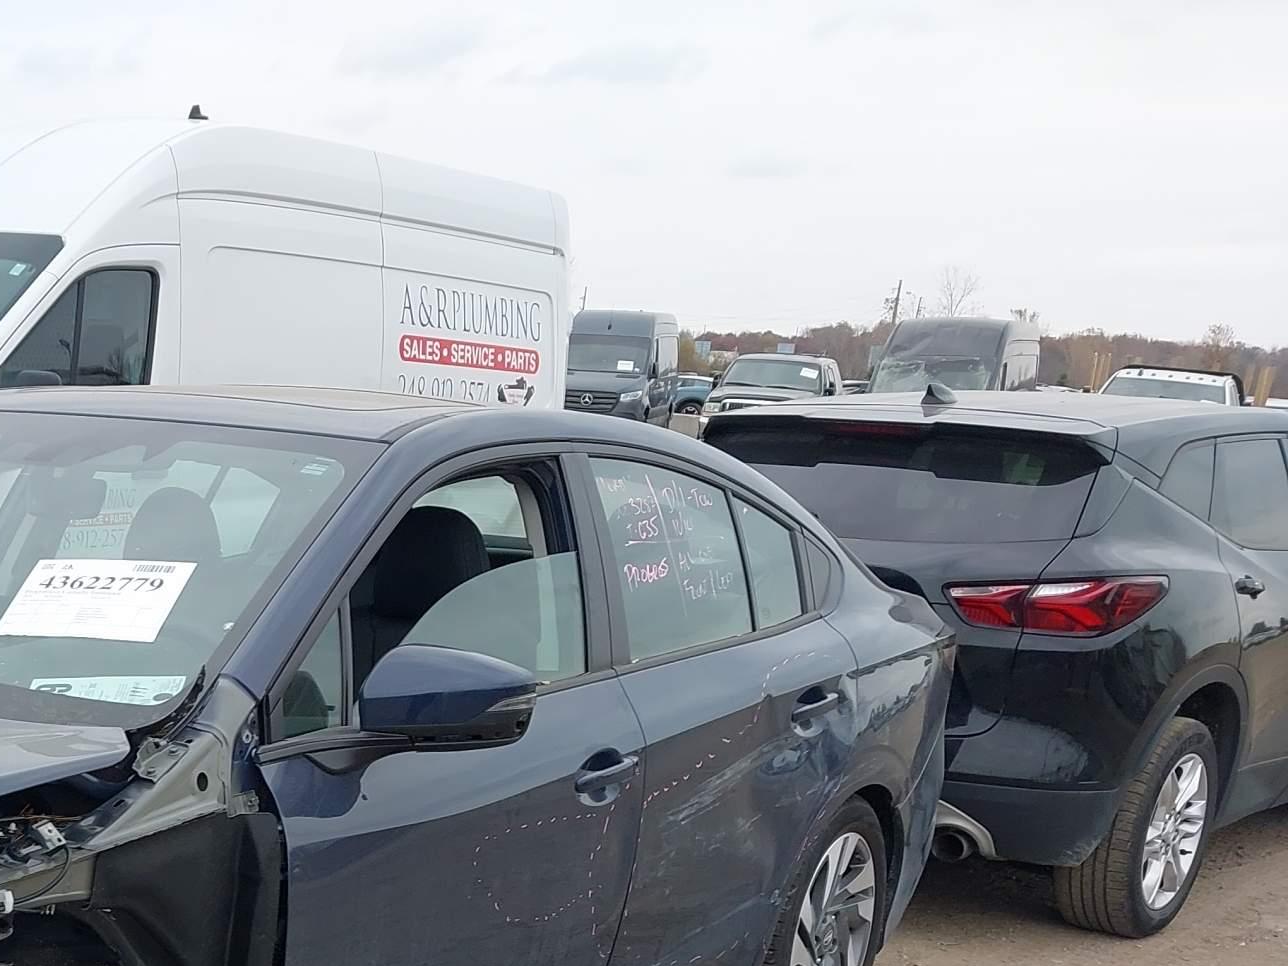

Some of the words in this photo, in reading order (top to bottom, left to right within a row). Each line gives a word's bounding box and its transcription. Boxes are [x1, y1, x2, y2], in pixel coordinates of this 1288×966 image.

[403, 338, 441, 361] SALES
[450, 344, 495, 368] SERVICE
[504, 350, 537, 372] PARTS
[39, 575, 164, 593] 43622779
